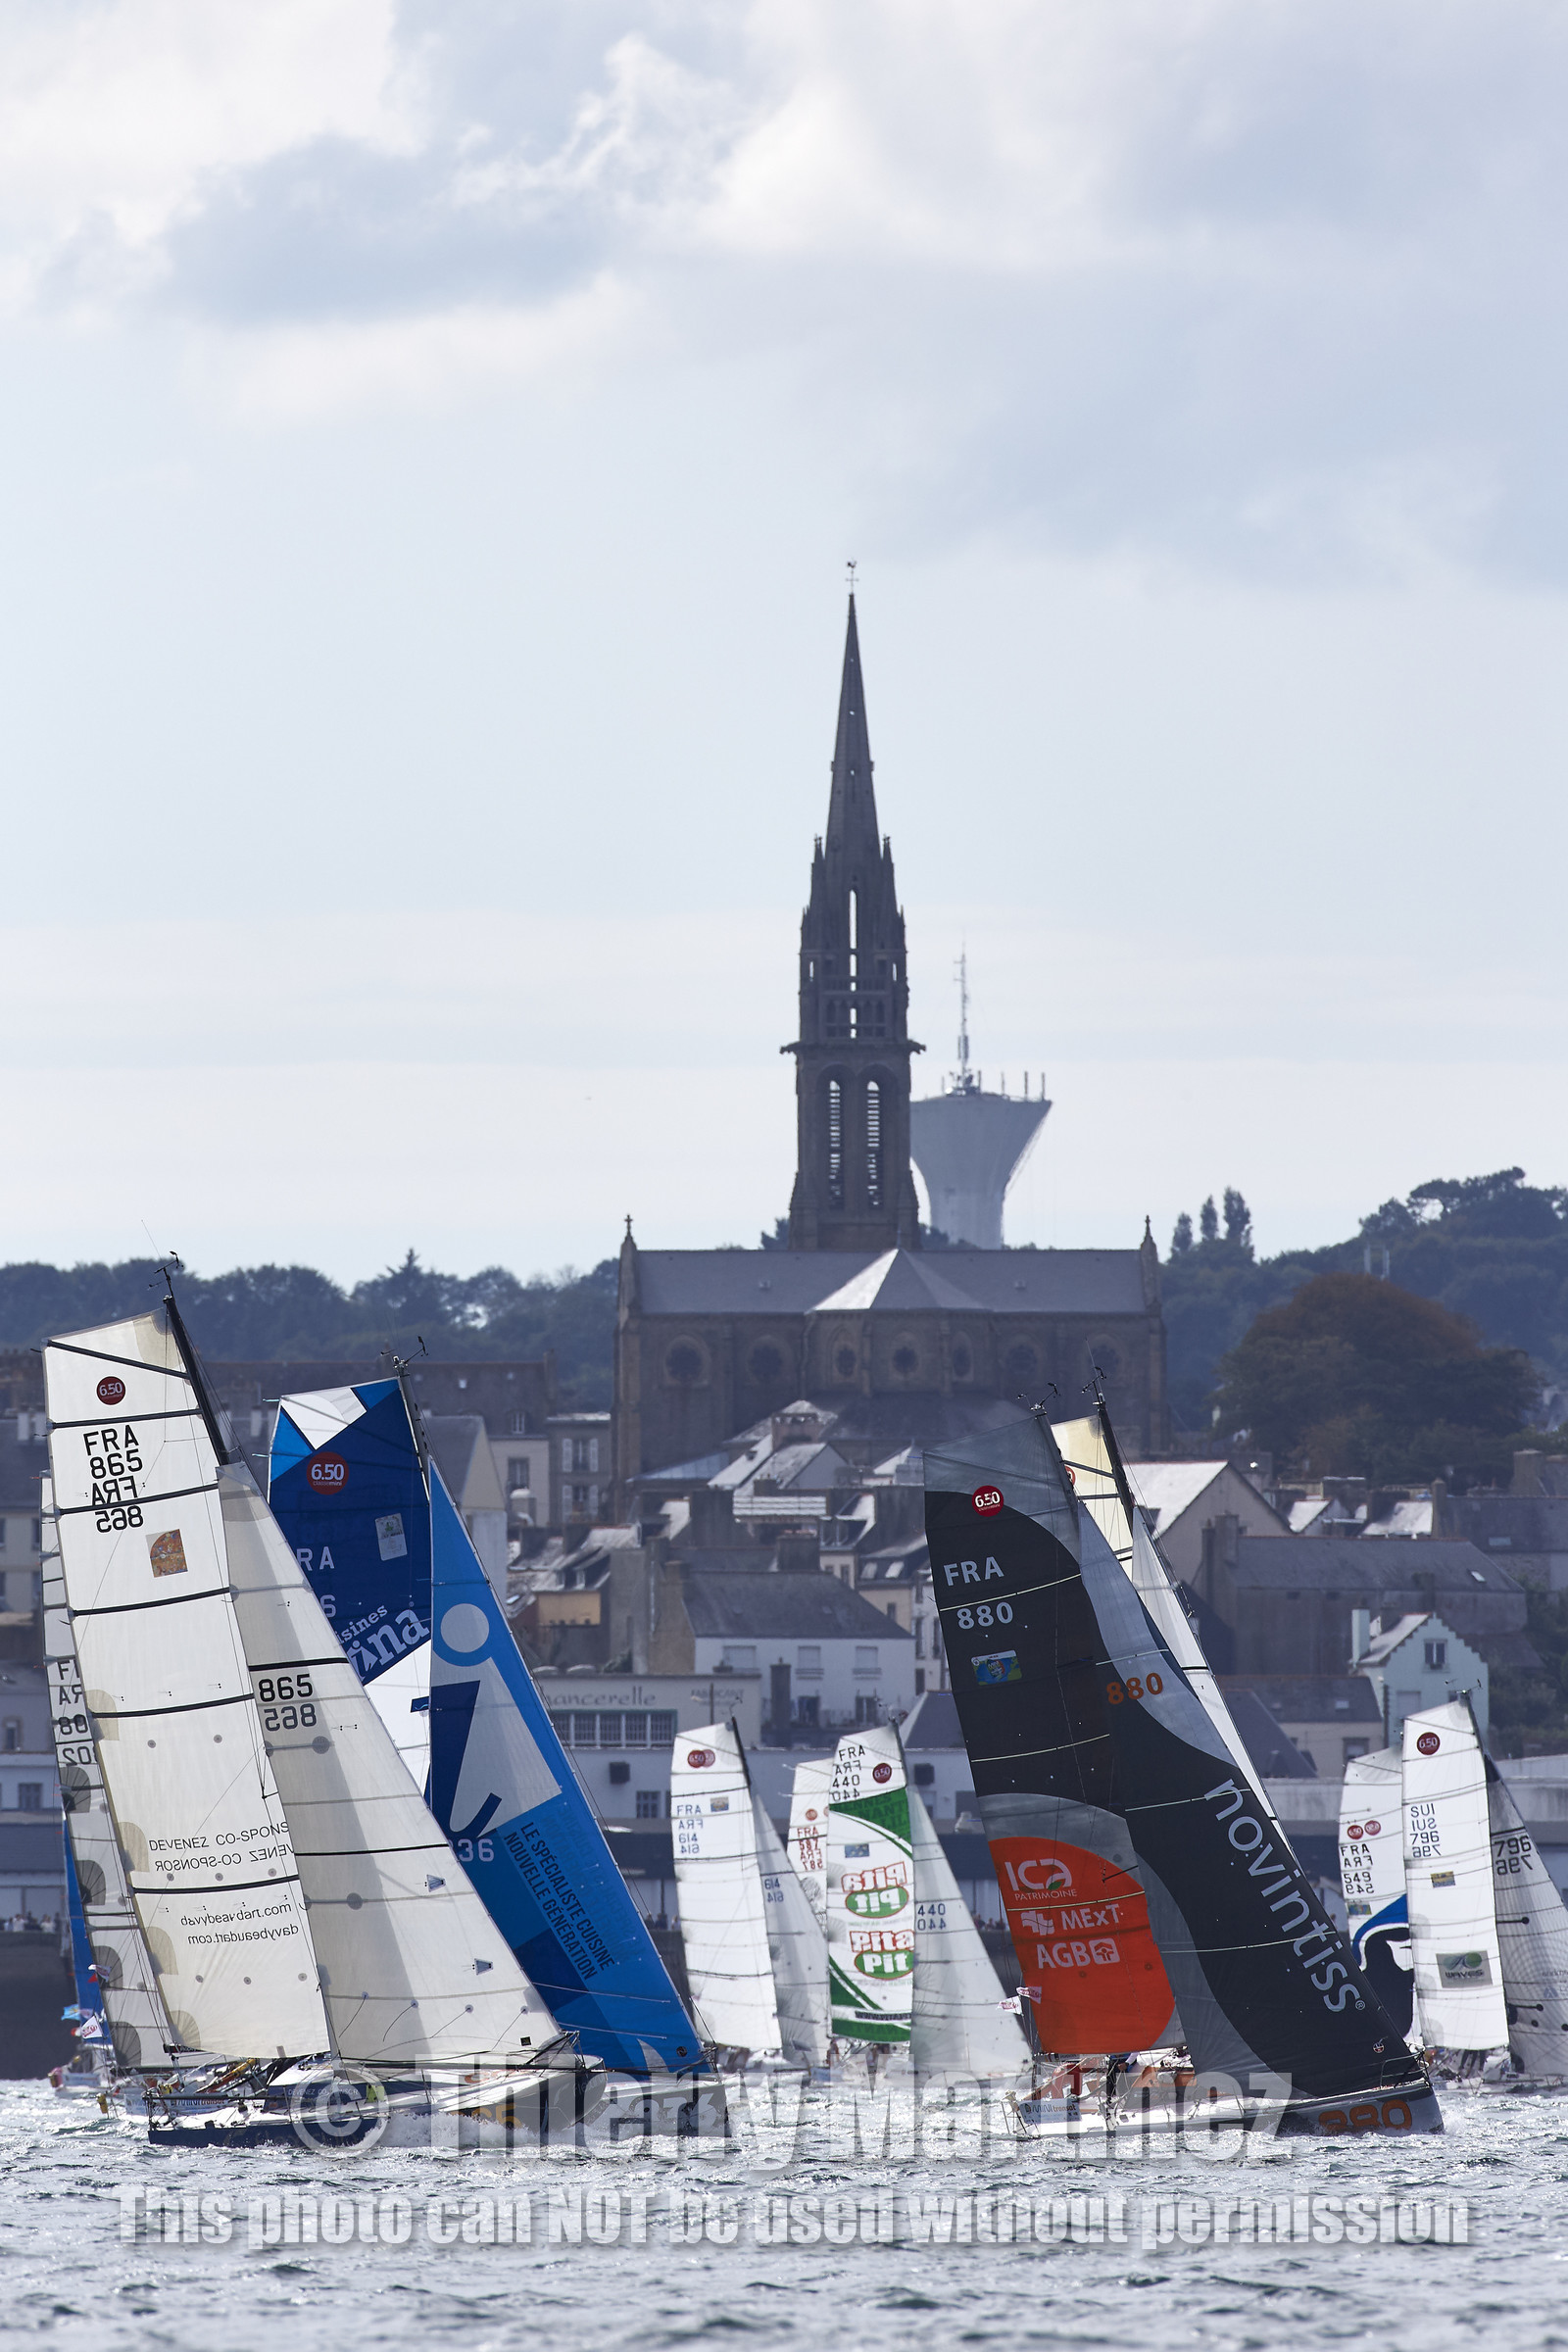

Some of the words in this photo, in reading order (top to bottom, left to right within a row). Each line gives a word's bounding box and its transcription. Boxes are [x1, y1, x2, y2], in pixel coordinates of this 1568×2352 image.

[83, 1424, 139, 1455] FRA
[89, 1448, 143, 1479] 865
[311, 1463, 345, 1481] 6.50
[943, 1556, 1004, 1587] FRA
[956, 1601, 1013, 1630] 880
[258, 1673, 314, 1702] 865
[1105, 1672, 1163, 1705] 880
[838, 1744, 865, 1761] FRA
[832, 1774, 860, 1788] 440
[676, 1804, 702, 1816] FRA
[1410, 1803, 1436, 1818] SUI
[149, 1836, 210, 1851] DEVENEZ
[216, 1821, 290, 1846] CO-SPONS
[678, 1834, 698, 1843] 614
[1409, 1830, 1440, 1845] 796
[1340, 1843, 1370, 1856] FRA
[1494, 1835, 1532, 1858] 796
[764, 1878, 780, 1889] 614
[1343, 1872, 1372, 1884] 549
[519, 1821, 540, 1841] LE
[530, 1838, 585, 1922] SPÉCIALISTE
[576, 1917, 615, 1972] CUISINE
[1014, 1888, 1077, 1901] PATRIMOINE
[503, 1832, 552, 1900] NOUVELLE
[542, 1895, 598, 1982] GÉNÉRATION
[917, 1903, 946, 1916] 440
[1036, 1941, 1092, 1969] AGB
